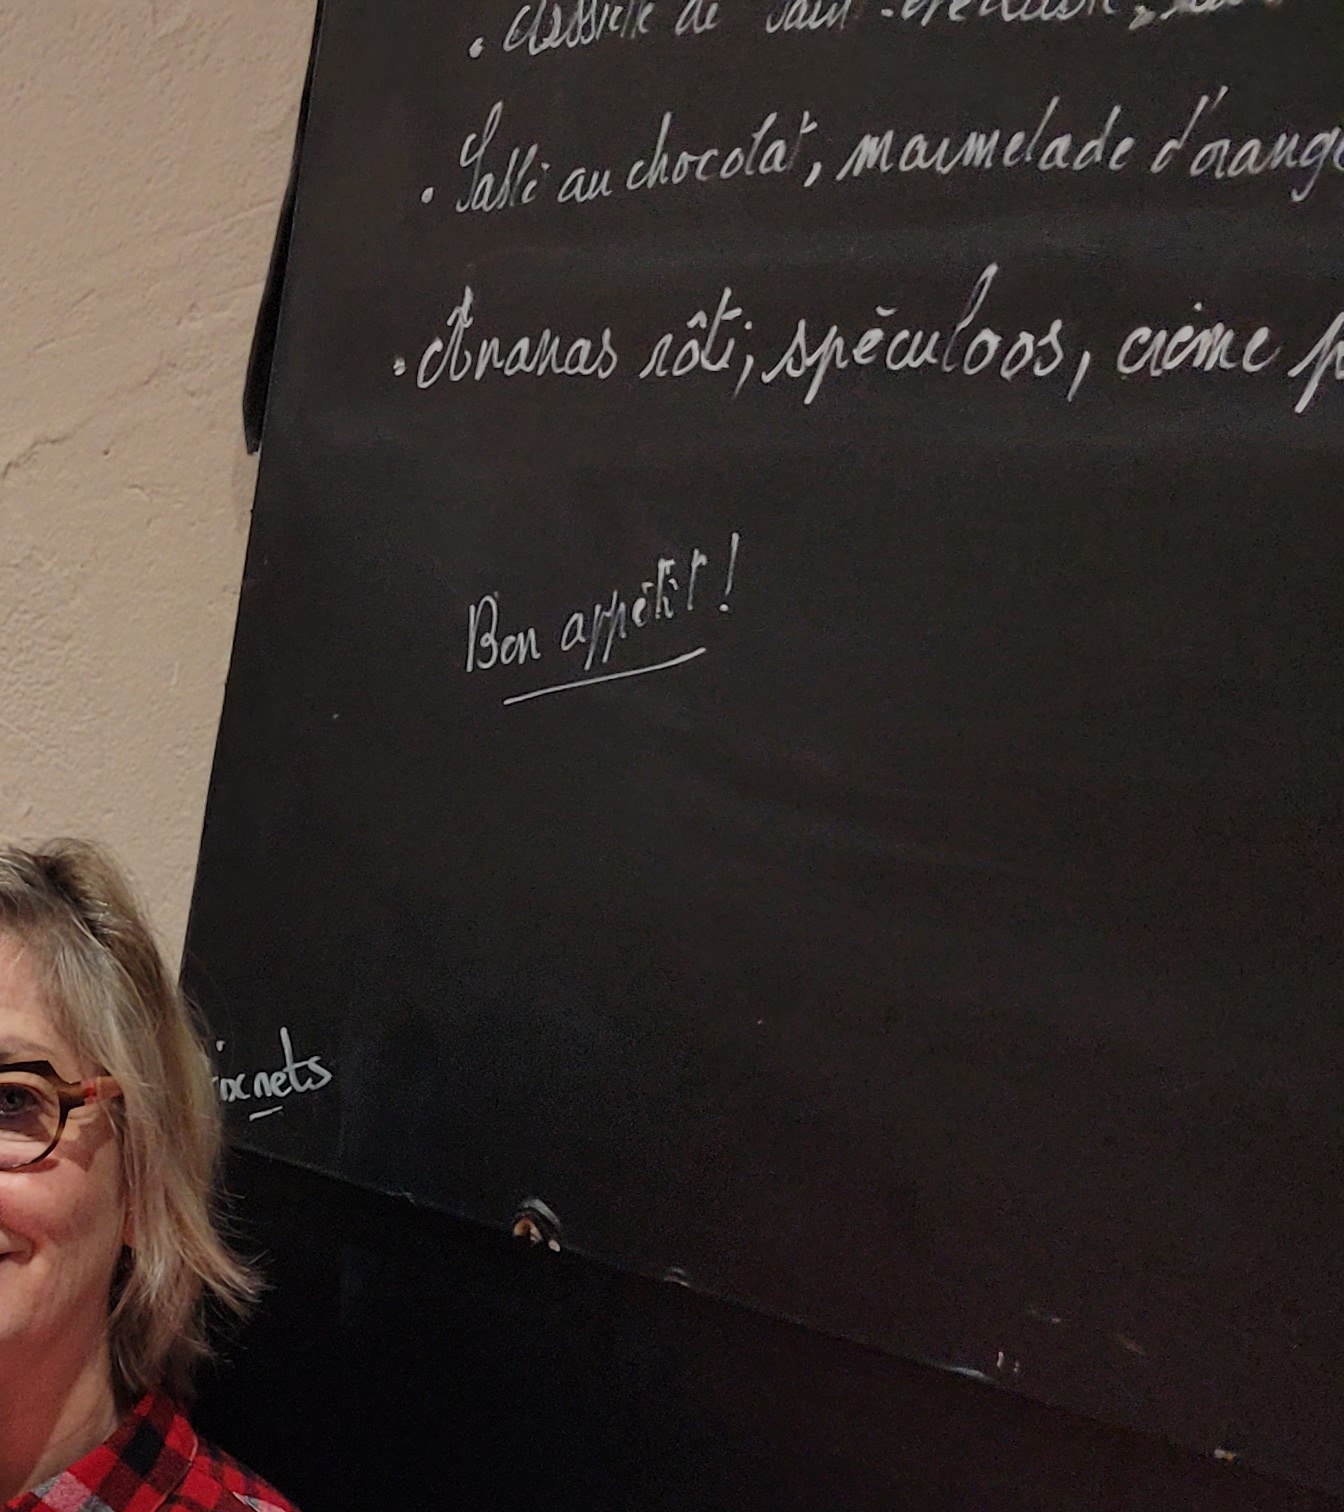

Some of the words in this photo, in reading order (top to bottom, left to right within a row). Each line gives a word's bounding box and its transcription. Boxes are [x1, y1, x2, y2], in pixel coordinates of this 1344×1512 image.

[557, 166, 612, 203] au
[625, 110, 821, 188] chocolat,
[835, 96, 1136, 182] marmelade
[416, 285, 618, 390] Ananas
[466, 592, 542, 672] Bon
